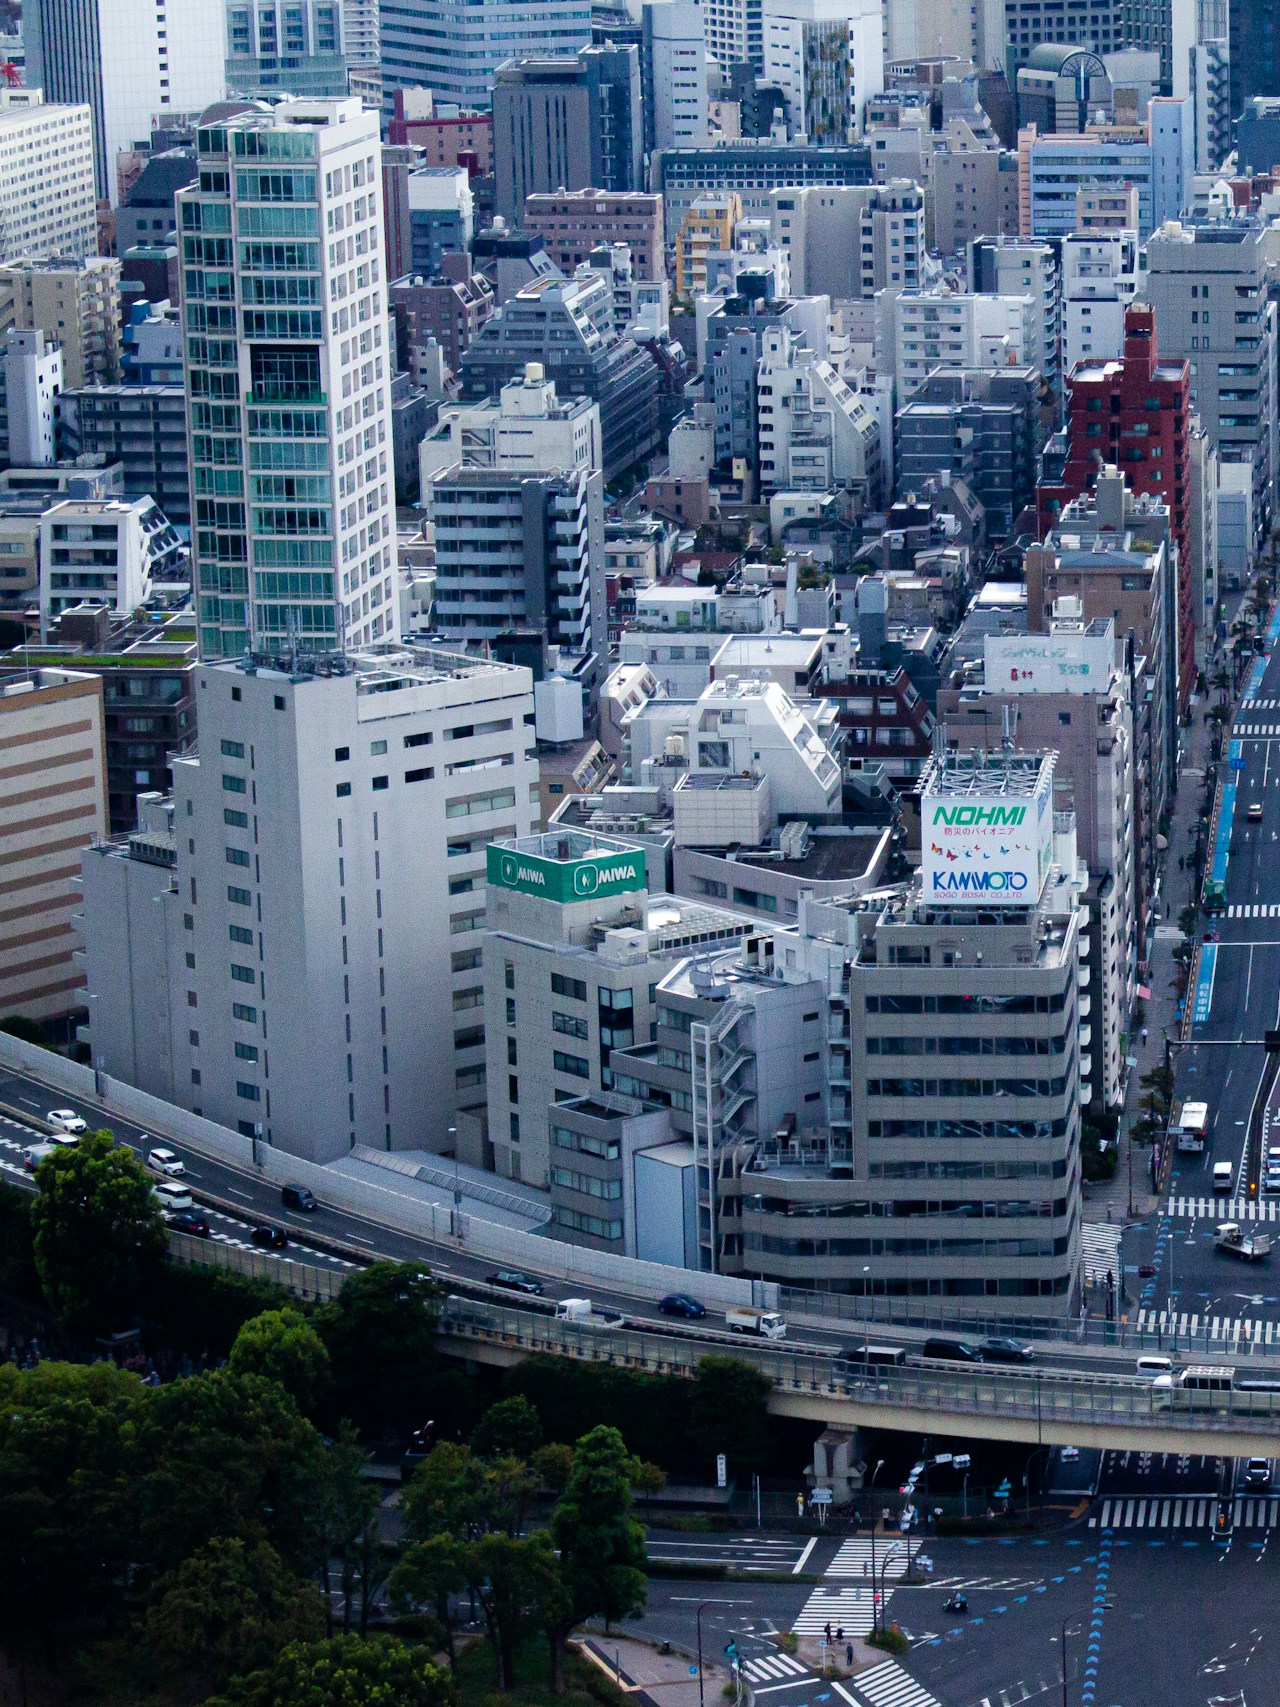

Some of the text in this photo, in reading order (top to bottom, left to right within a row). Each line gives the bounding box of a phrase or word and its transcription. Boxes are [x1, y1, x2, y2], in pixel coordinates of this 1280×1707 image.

[932, 806, 1027, 826] NOHMI
[944, 827, 1015, 836] 防災のパイオニア
[518, 866, 546, 886] MIWA
[598, 864, 637, 885] MIWA
[933, 891, 958, 899] SOGO
[961, 891, 987, 899] BOSAI
[1195, 983, 1210, 1022] 自転車専用
